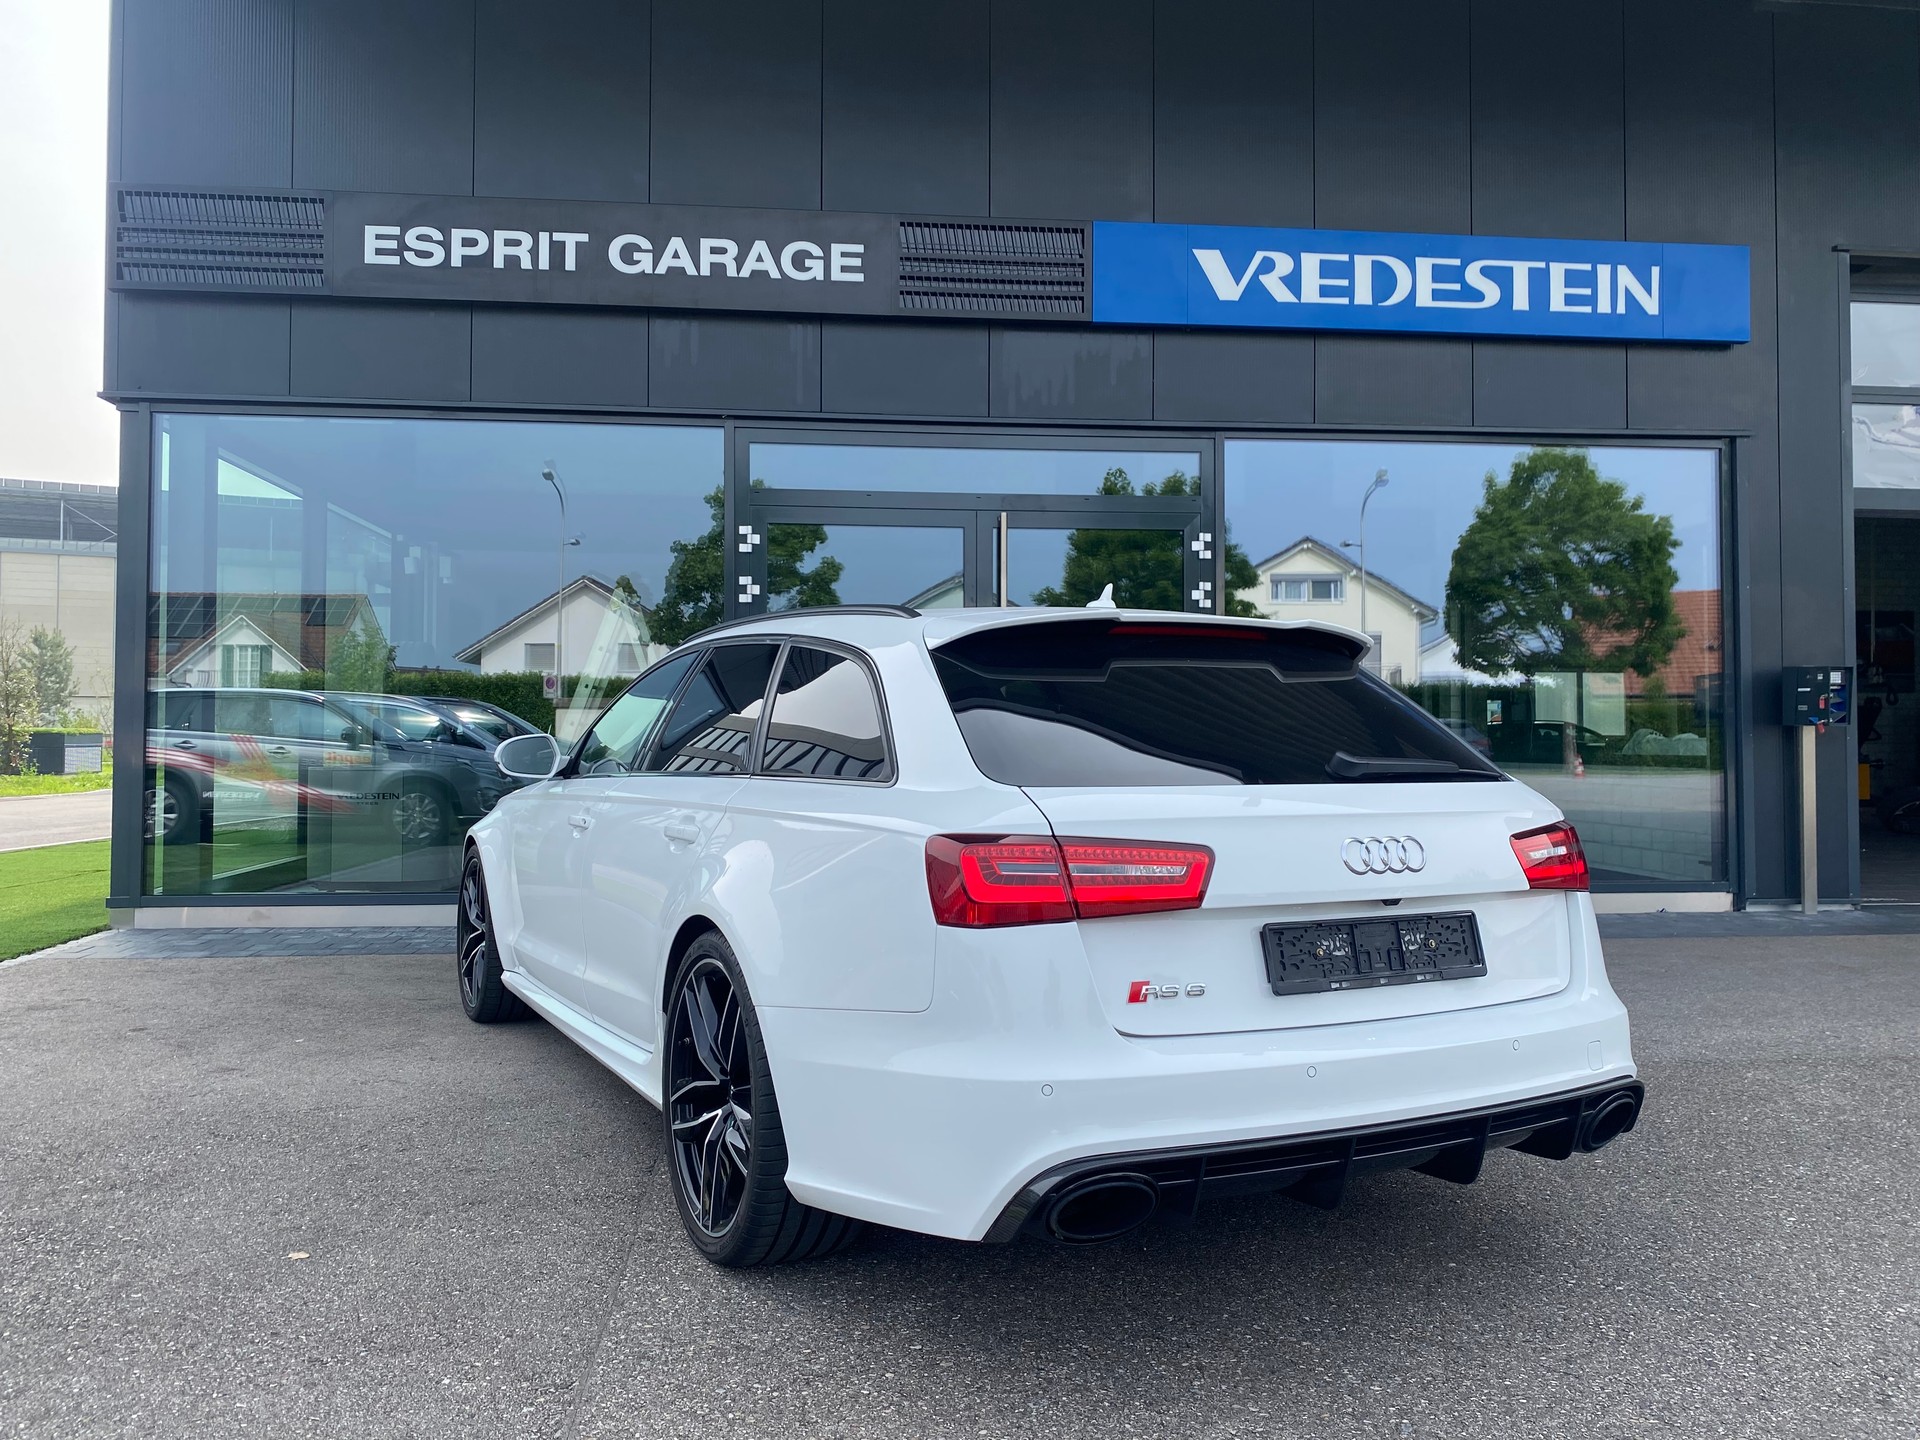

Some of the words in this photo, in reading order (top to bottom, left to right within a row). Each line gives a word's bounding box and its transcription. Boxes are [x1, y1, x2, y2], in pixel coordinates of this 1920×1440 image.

[364, 225, 589, 271] ESPRIT
[608, 234, 865, 282] GARAGE
[1191, 248, 1660, 315] VREDESTEIN
[1140, 984, 1180, 1000] RS
[1185, 982, 1206, 998] 6
